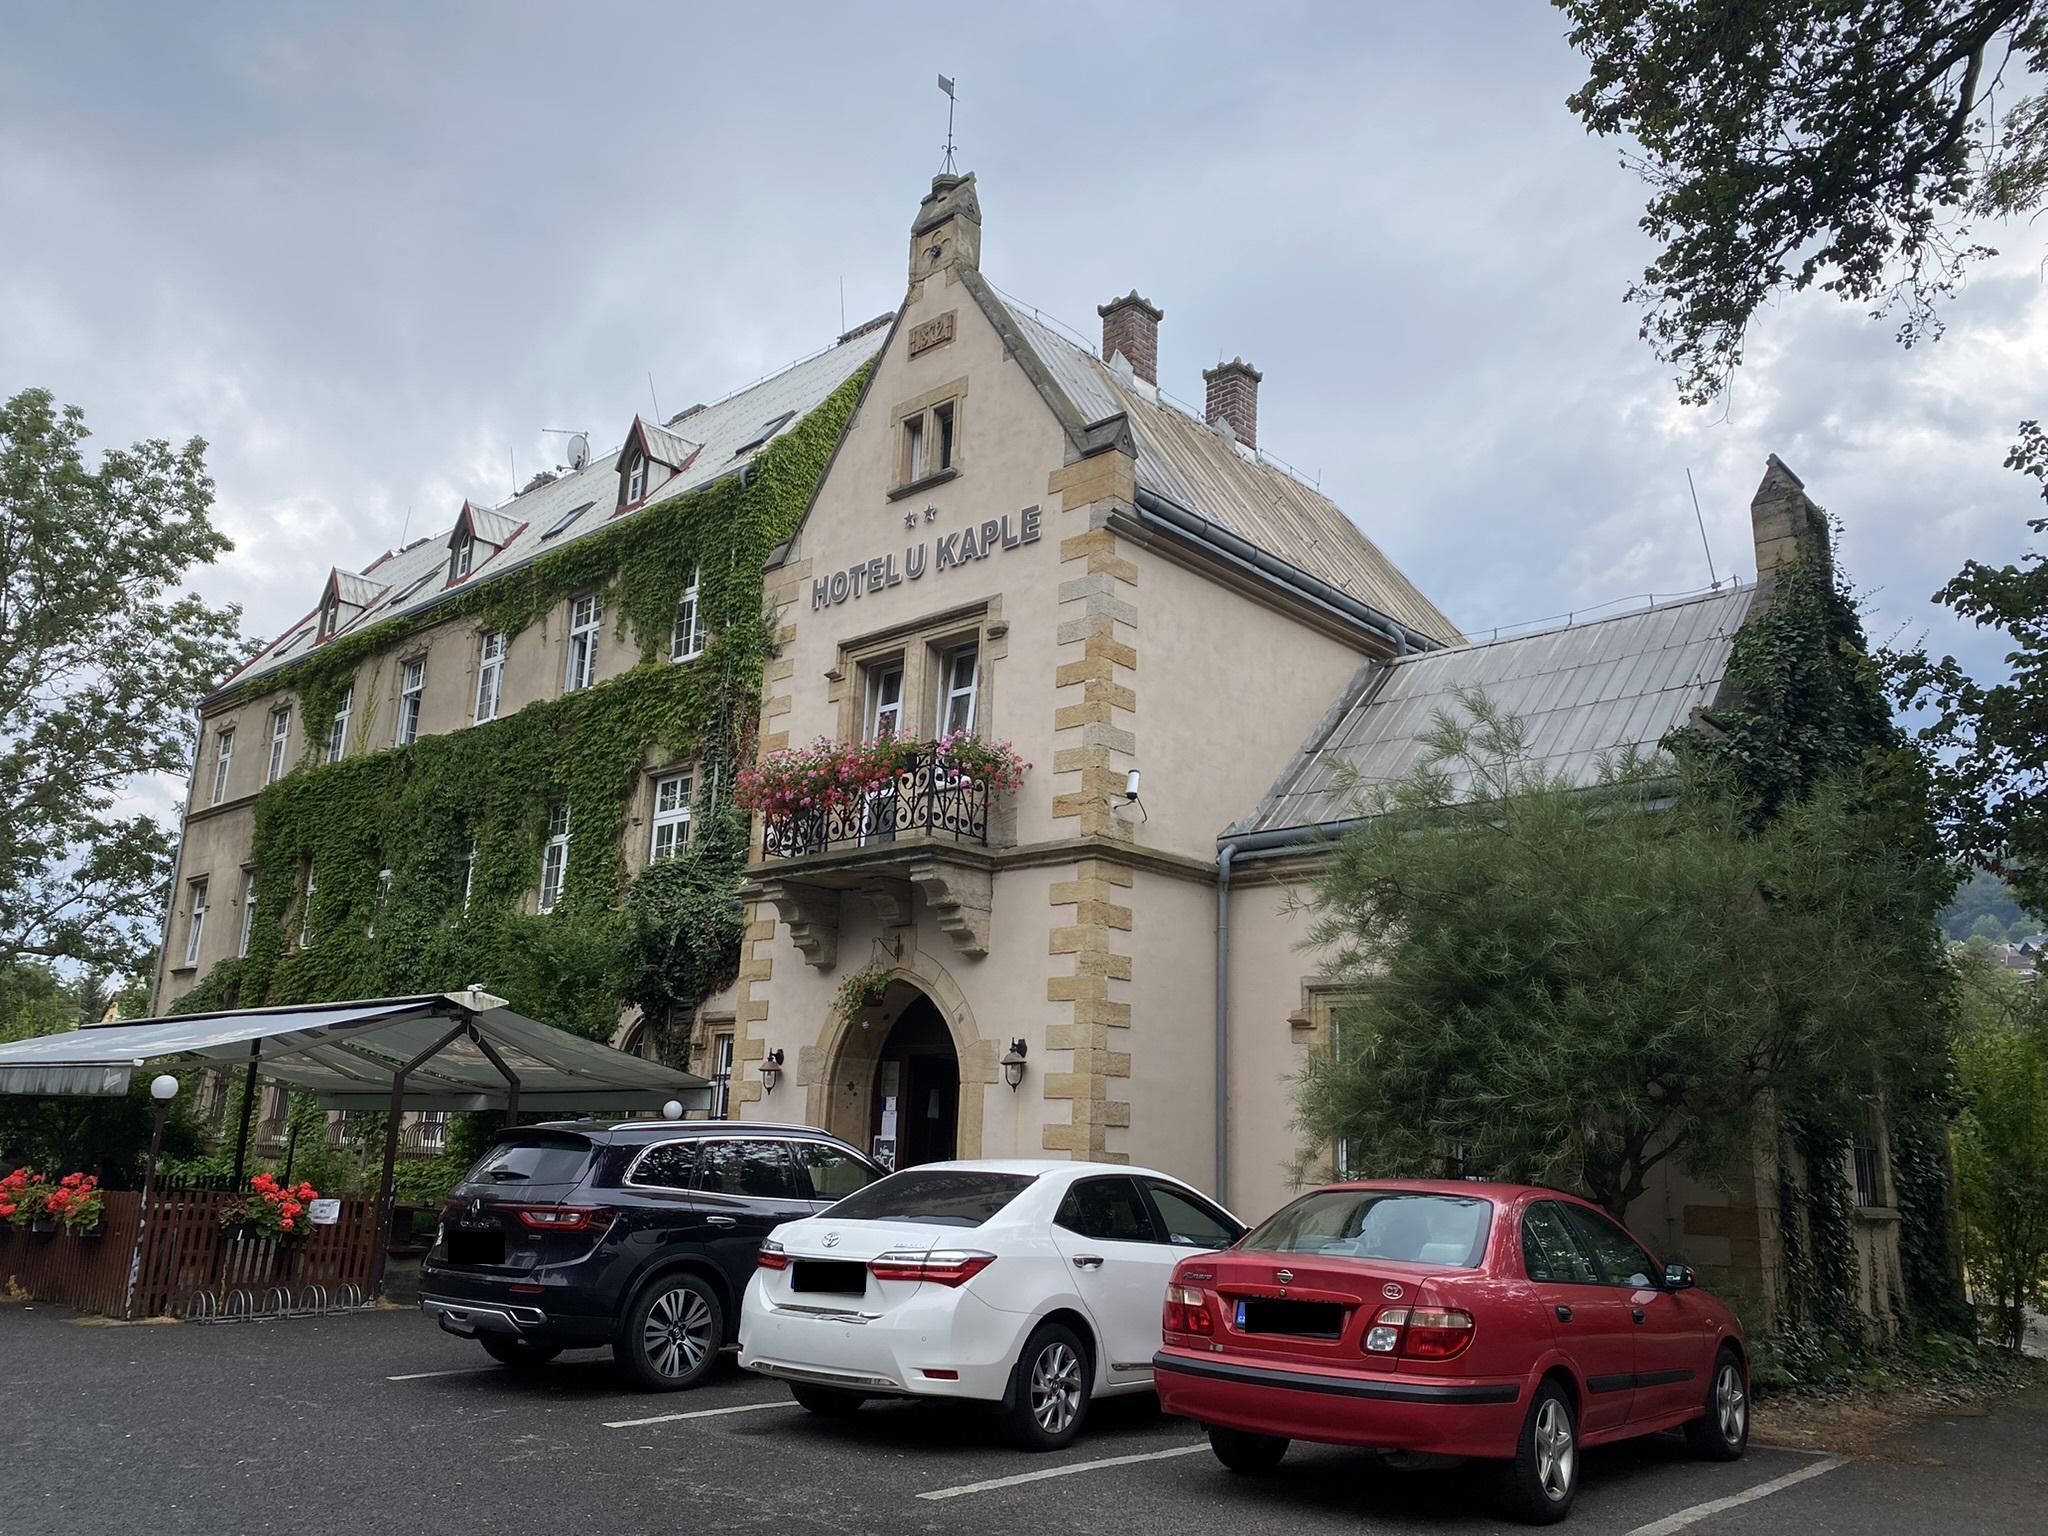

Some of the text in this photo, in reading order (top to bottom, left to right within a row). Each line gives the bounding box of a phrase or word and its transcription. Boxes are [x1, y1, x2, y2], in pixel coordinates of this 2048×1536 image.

[811, 504, 1041, 611] HOTEL U KAPLE
[1385, 1286, 1400, 1297] CZ
